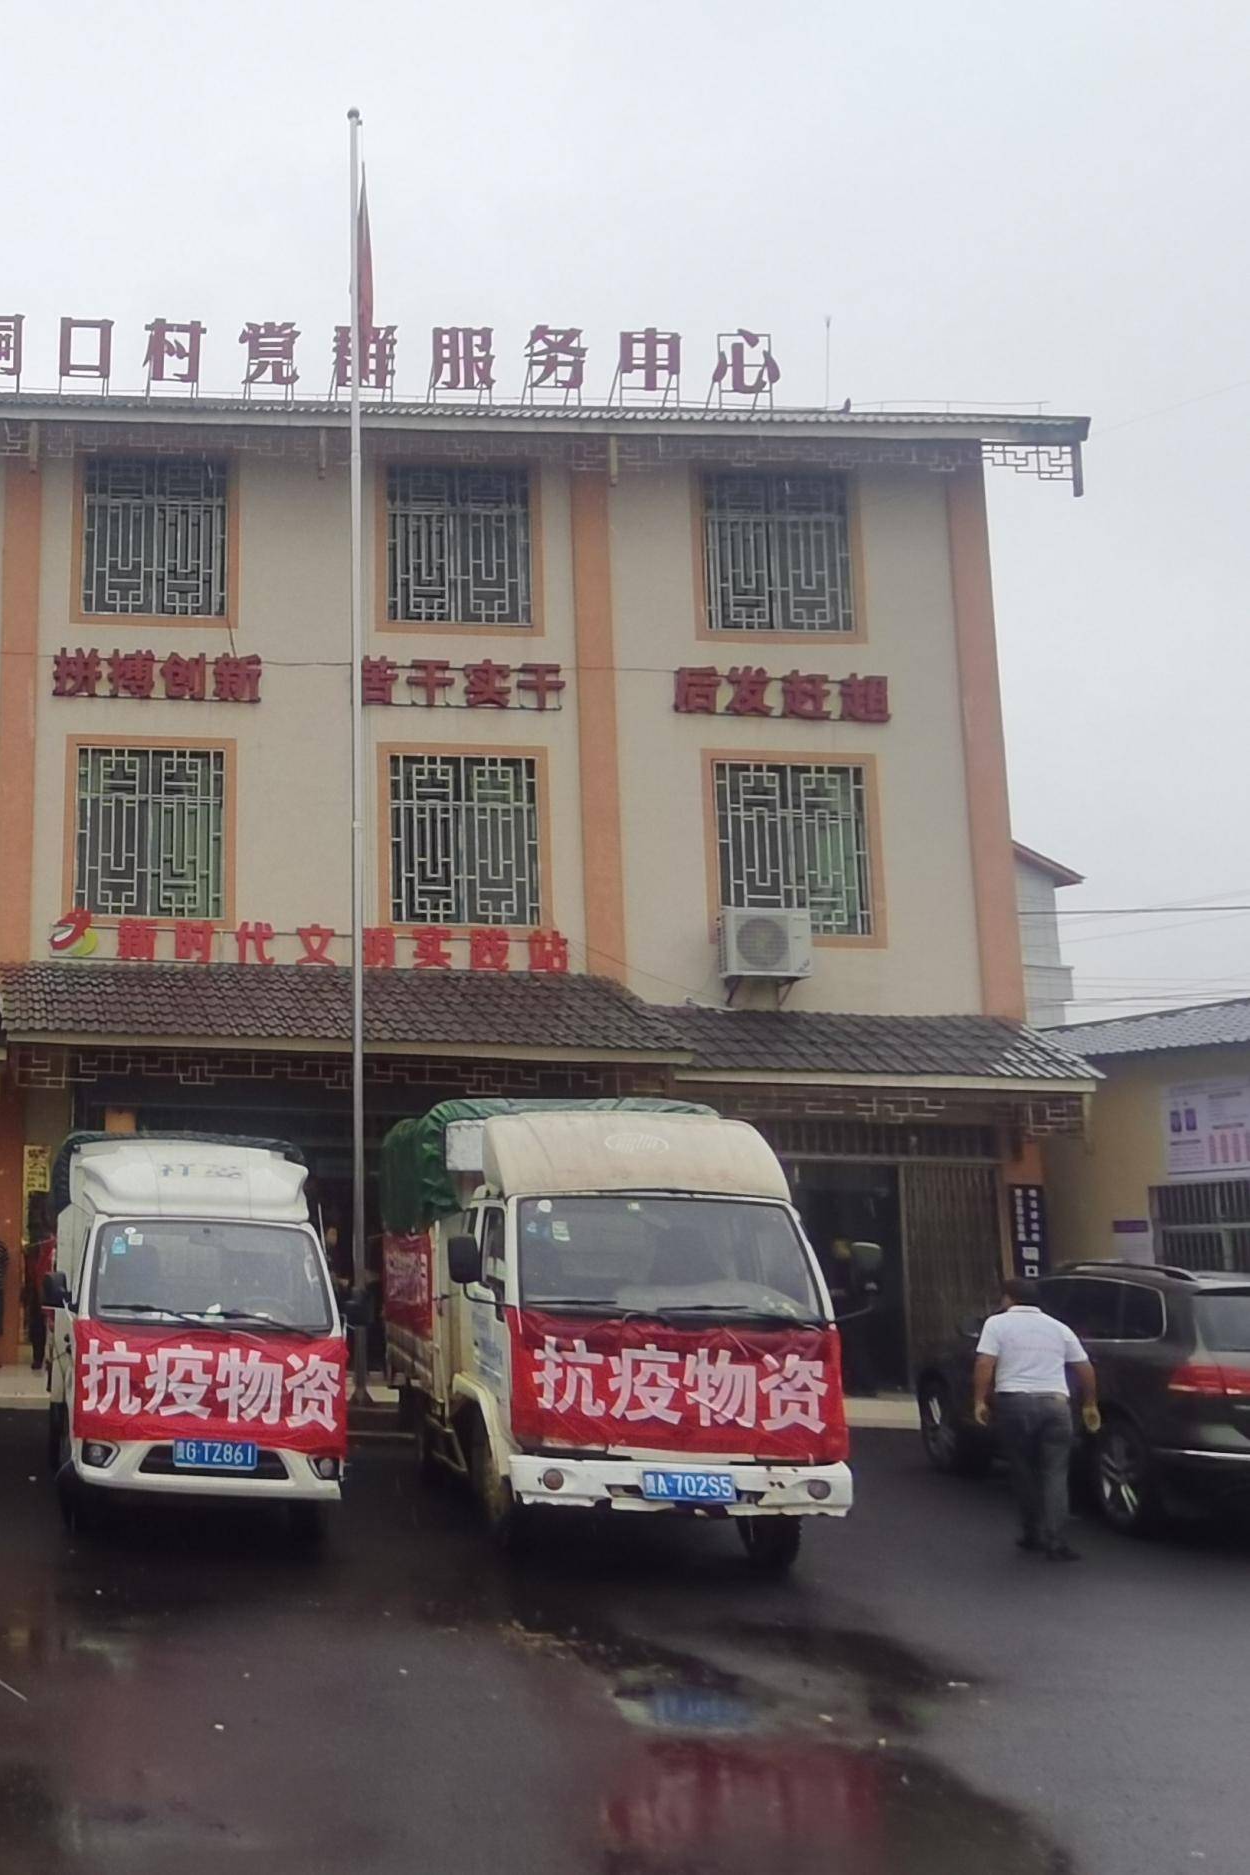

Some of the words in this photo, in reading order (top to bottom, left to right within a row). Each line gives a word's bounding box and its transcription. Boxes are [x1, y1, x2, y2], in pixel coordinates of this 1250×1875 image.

[53, 647, 261, 702] 拼搏创新
[361, 655, 565, 711] 苦干实干
[674, 666, 891, 722] 后发赶超
[117, 917, 569, 973] 新时代文明实践站
[81, 1338, 341, 1432] 抗疫物资
[532, 1335, 828, 1434] 抗疫物资
